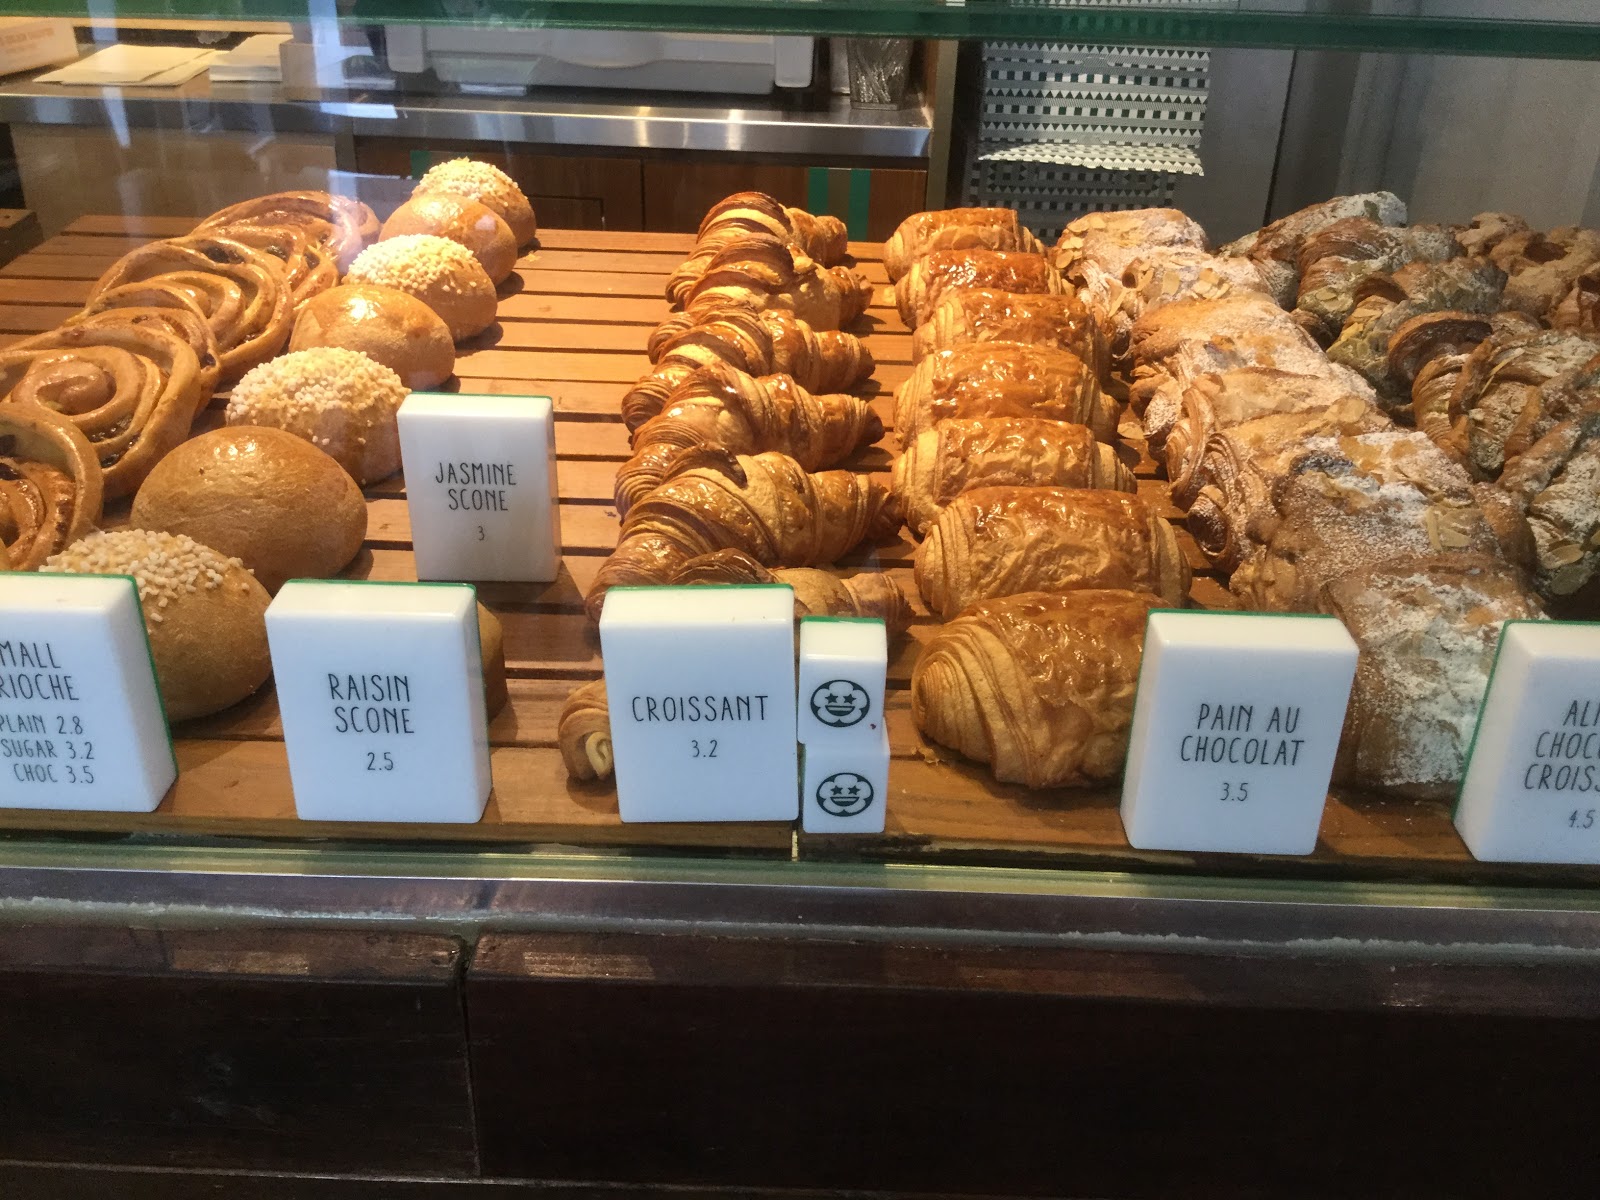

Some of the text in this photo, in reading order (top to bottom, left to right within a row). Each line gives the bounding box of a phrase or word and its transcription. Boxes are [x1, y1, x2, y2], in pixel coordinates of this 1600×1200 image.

[435, 462, 516, 486] JASMINE
[448, 489, 508, 511] SCONE
[477, 525, 485, 541] 3
[328, 673, 411, 702] RAISIN
[631, 695, 769, 722] CROISSANT
[1197, 703, 1300, 733] PAIN AU
[56, 715, 83, 735] 2.8
[334, 706, 415, 734] SCONE
[1, 738, 94, 760] SUGAR 3.2
[691, 739, 718, 758] 3.2
[1180, 735, 1305, 766] CHOCOLAT
[1535, 731, 1600, 759] CHOC
[366, 751, 394, 771] 2.5
[13, 763, 94, 784] CHOC 3.5
[1220, 782, 1249, 802] 3.5
[1568, 809, 1596, 829] 4.5
